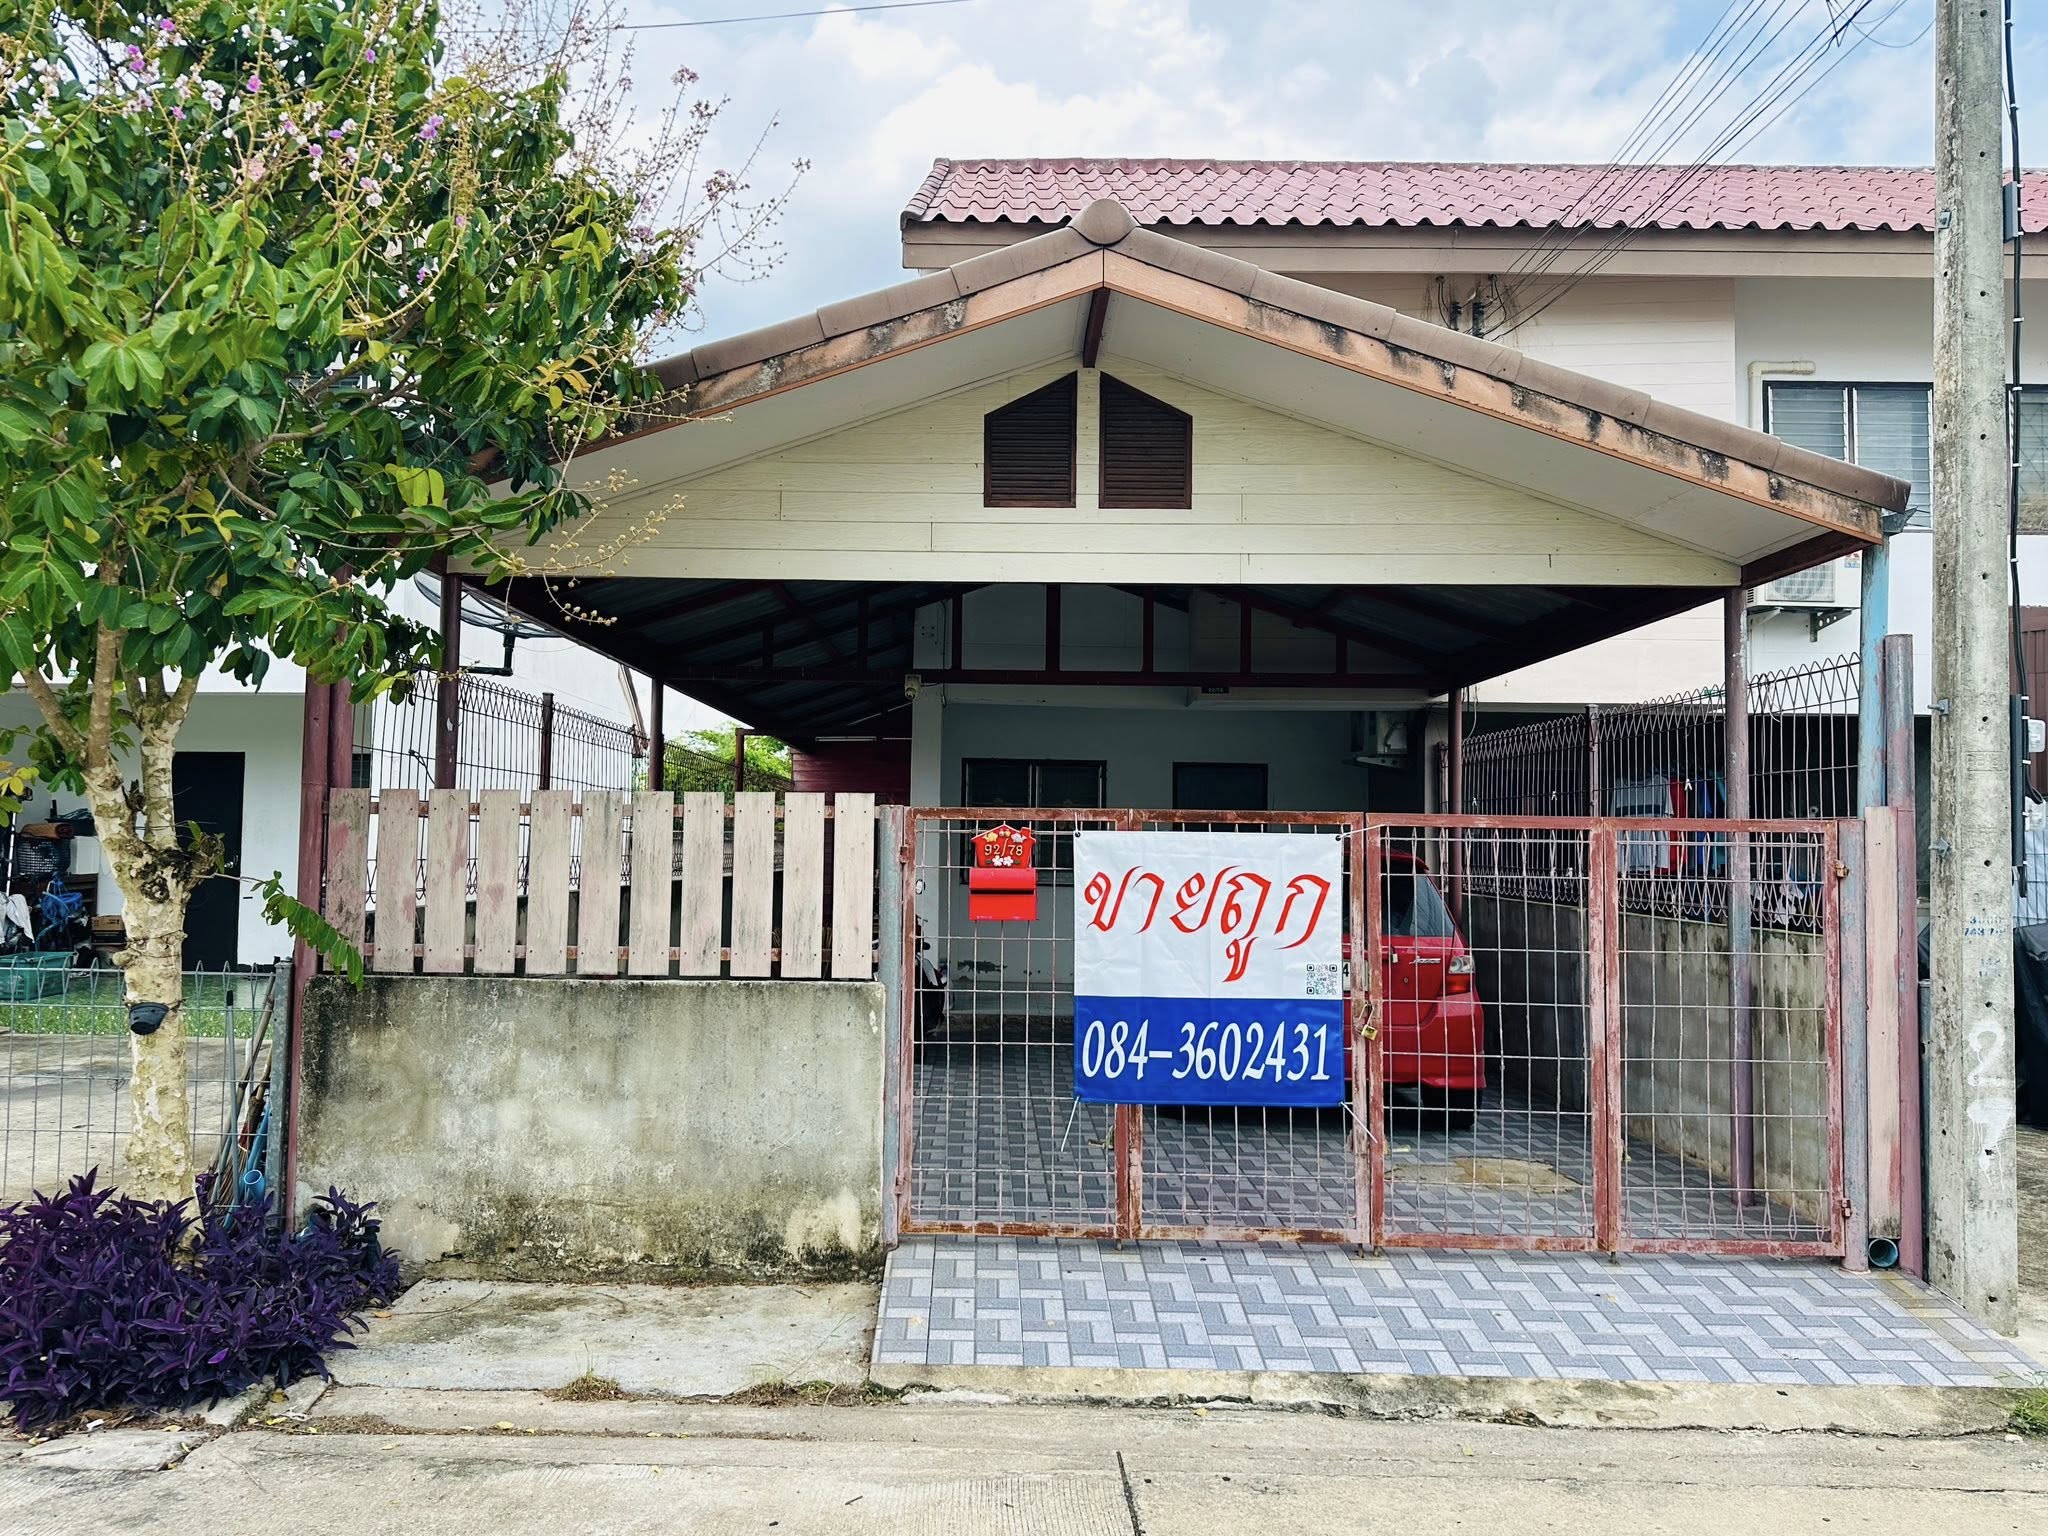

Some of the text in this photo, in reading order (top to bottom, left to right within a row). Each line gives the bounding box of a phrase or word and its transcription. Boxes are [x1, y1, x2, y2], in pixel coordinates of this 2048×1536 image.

[984, 838, 1024, 857] 92/78
[1083, 865, 1332, 983] ขายถูก
[1081, 1018, 1331, 1083] 084-3602431
